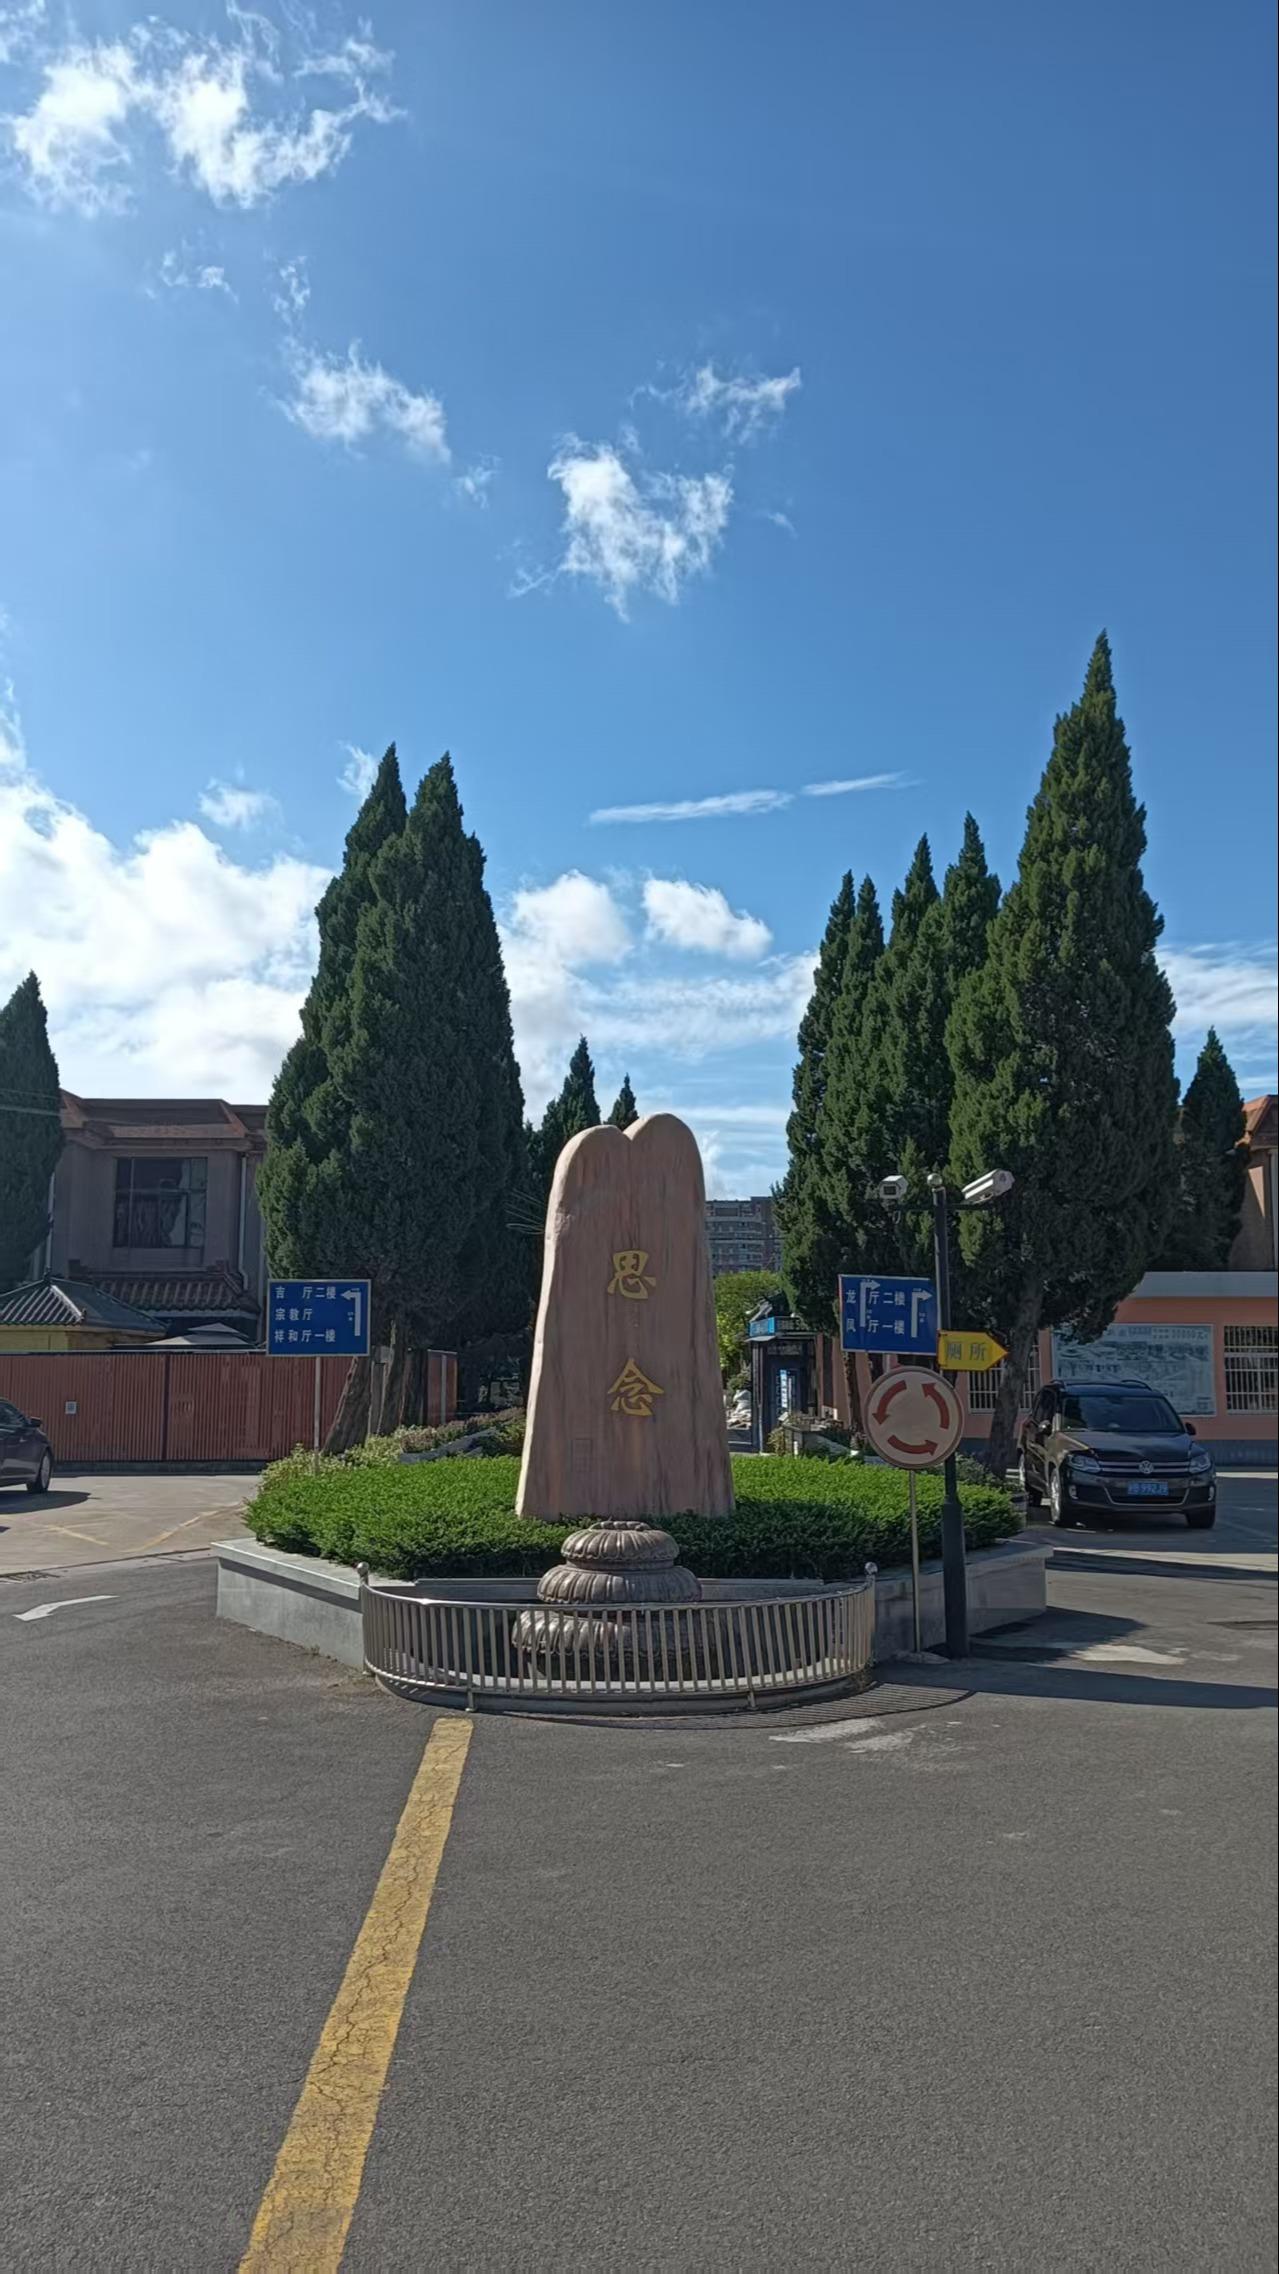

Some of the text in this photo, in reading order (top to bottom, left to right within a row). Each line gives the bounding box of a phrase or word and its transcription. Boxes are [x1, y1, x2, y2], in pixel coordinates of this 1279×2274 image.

[275, 1307, 313, 1321] 宗教厅
[274, 1329, 336, 1343] 祥和厅一楼
[947, 1342, 986, 1361] 厕所
